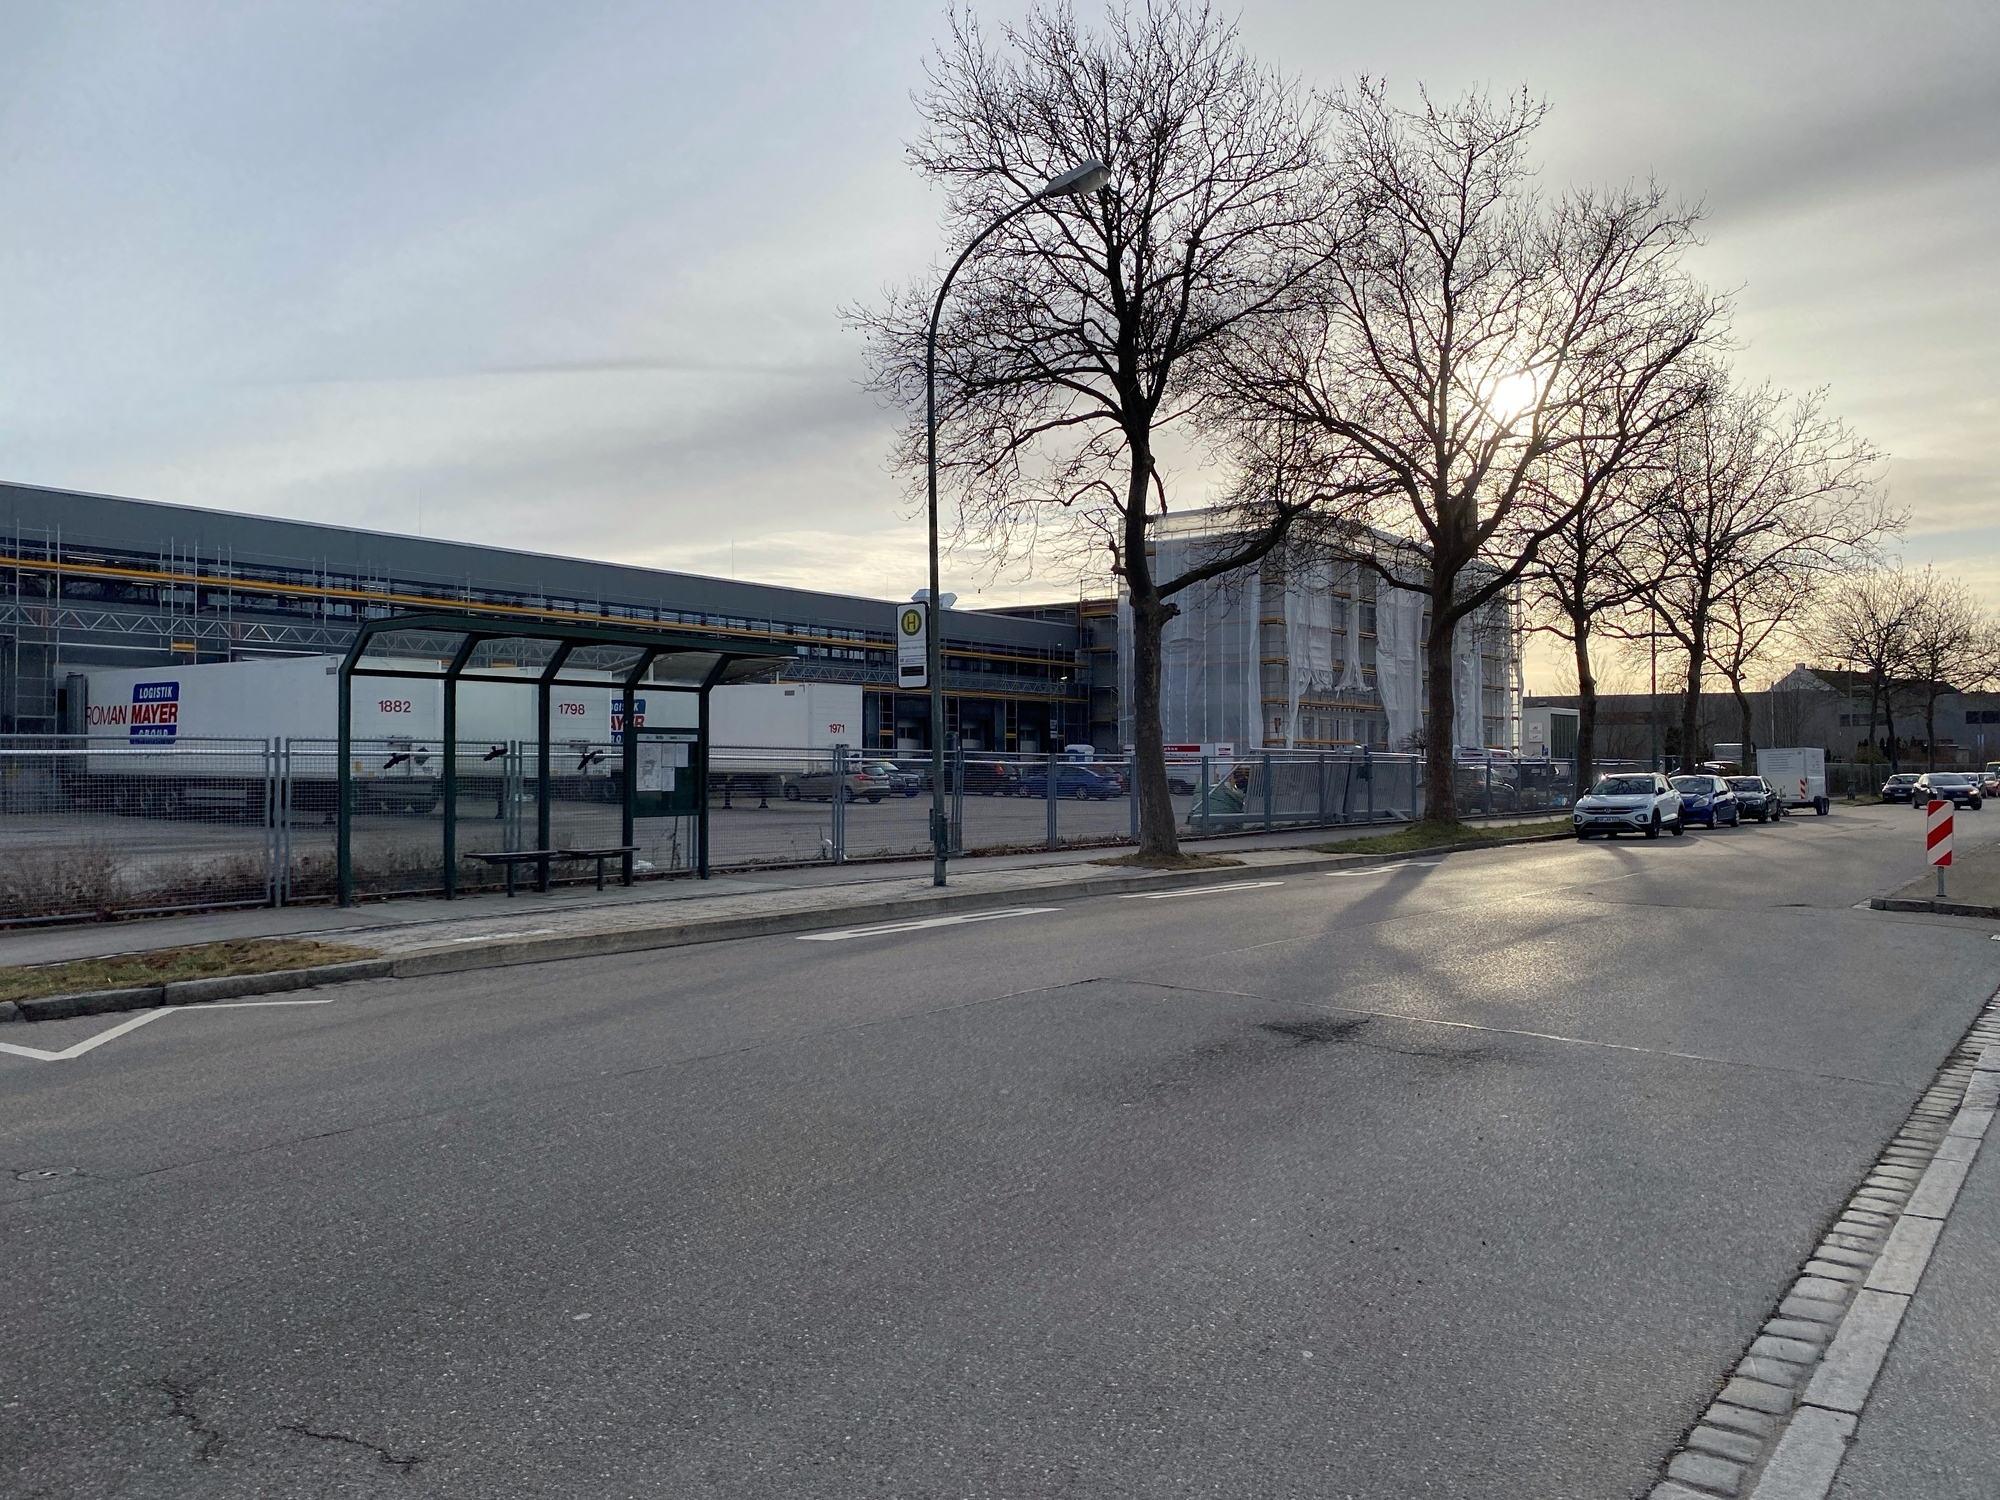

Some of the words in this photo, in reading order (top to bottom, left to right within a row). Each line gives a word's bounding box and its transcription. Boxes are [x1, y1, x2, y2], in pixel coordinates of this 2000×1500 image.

[906, 614, 916, 631] H
[139, 686, 173, 699] LOGISTIK
[378, 700, 411, 713] 1882
[558, 703, 585, 715] 1798
[87, 705, 127, 725] ROMAN
[131, 703, 178, 724] MAYER
[828, 724, 844, 733] 1971
